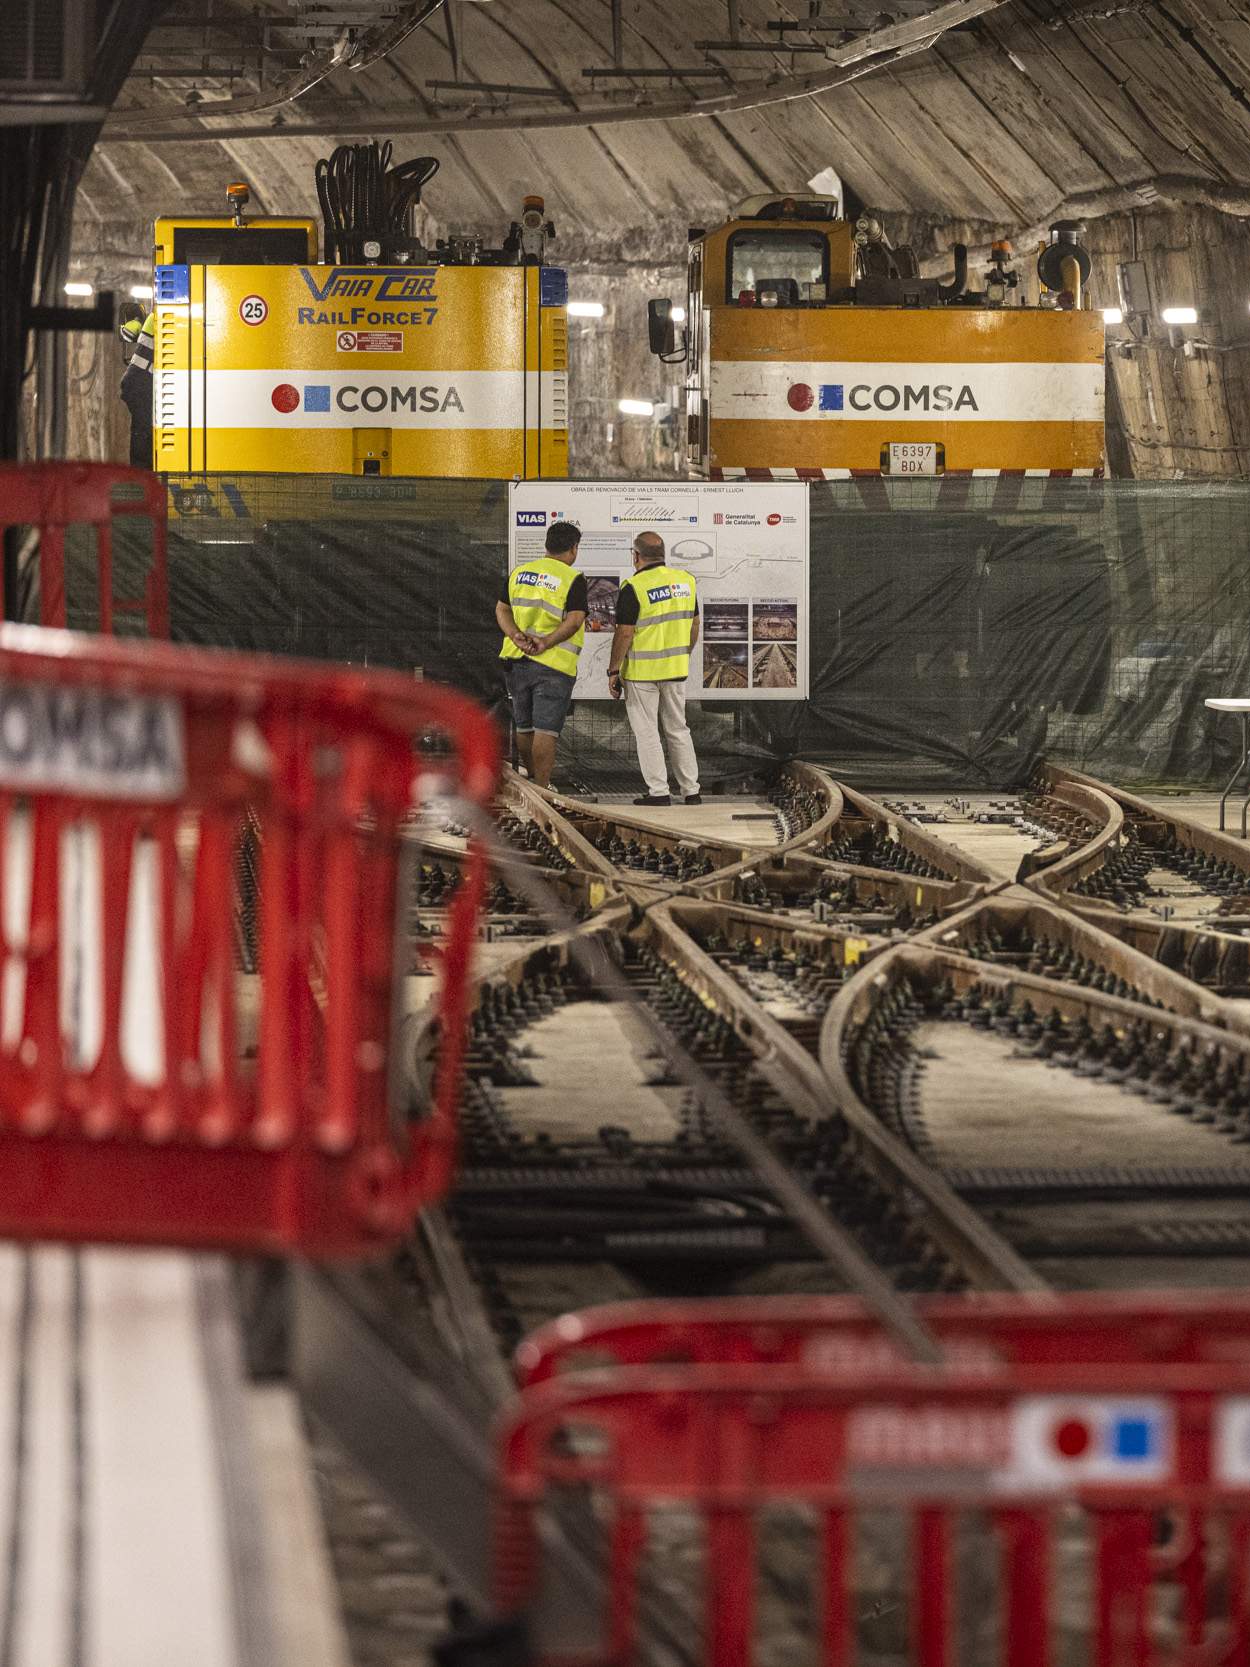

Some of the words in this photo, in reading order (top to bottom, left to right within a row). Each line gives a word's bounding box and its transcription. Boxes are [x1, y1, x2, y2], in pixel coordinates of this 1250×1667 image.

[375, 275, 438, 301] CAR
[245, 303, 263, 318] 25
[336, 386, 464, 412] COMSA
[849, 385, 979, 411] COMSA
[901, 461, 923, 472] BDX
[518, 514, 545, 523] VIAS
[517, 573, 537, 583] VIAS
[649, 589, 671, 600] VIAS
